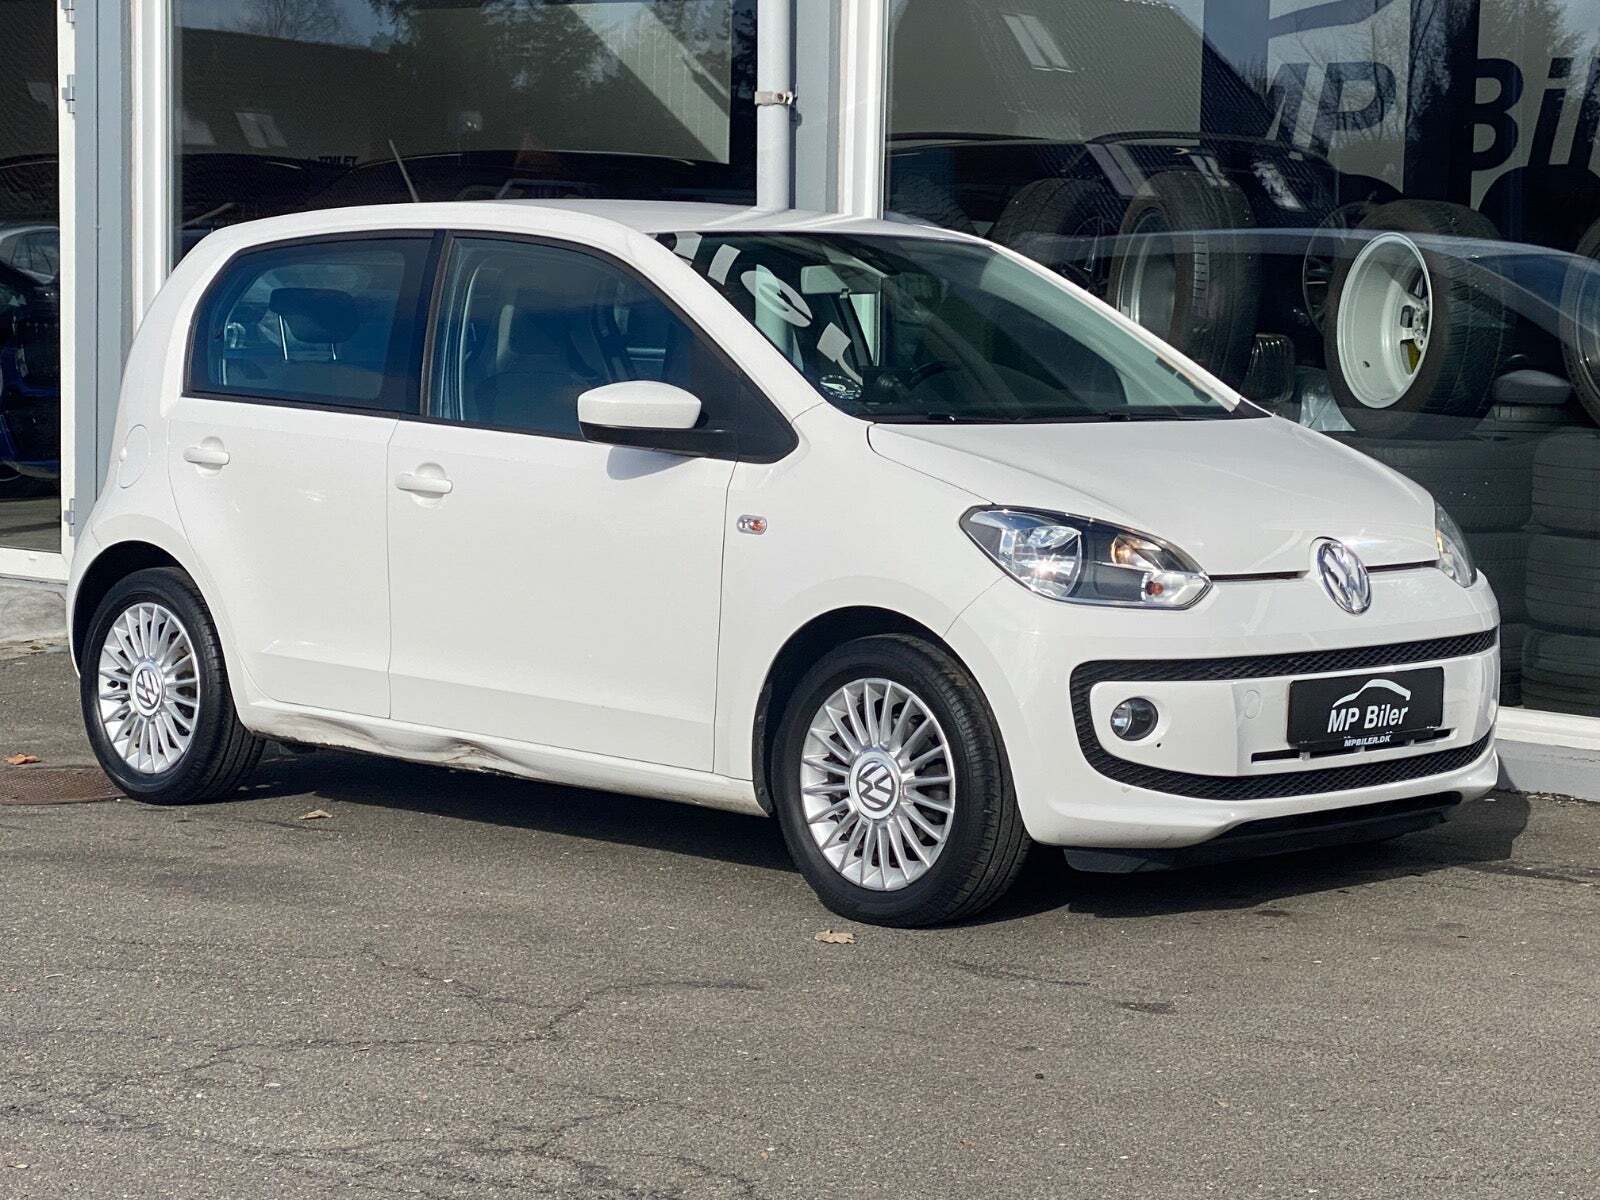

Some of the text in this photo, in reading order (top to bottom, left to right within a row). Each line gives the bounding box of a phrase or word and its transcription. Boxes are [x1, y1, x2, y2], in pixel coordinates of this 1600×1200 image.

[1327, 704, 1409, 733] MP Biler
[1343, 734, 1392, 747] MPBILER.DK
